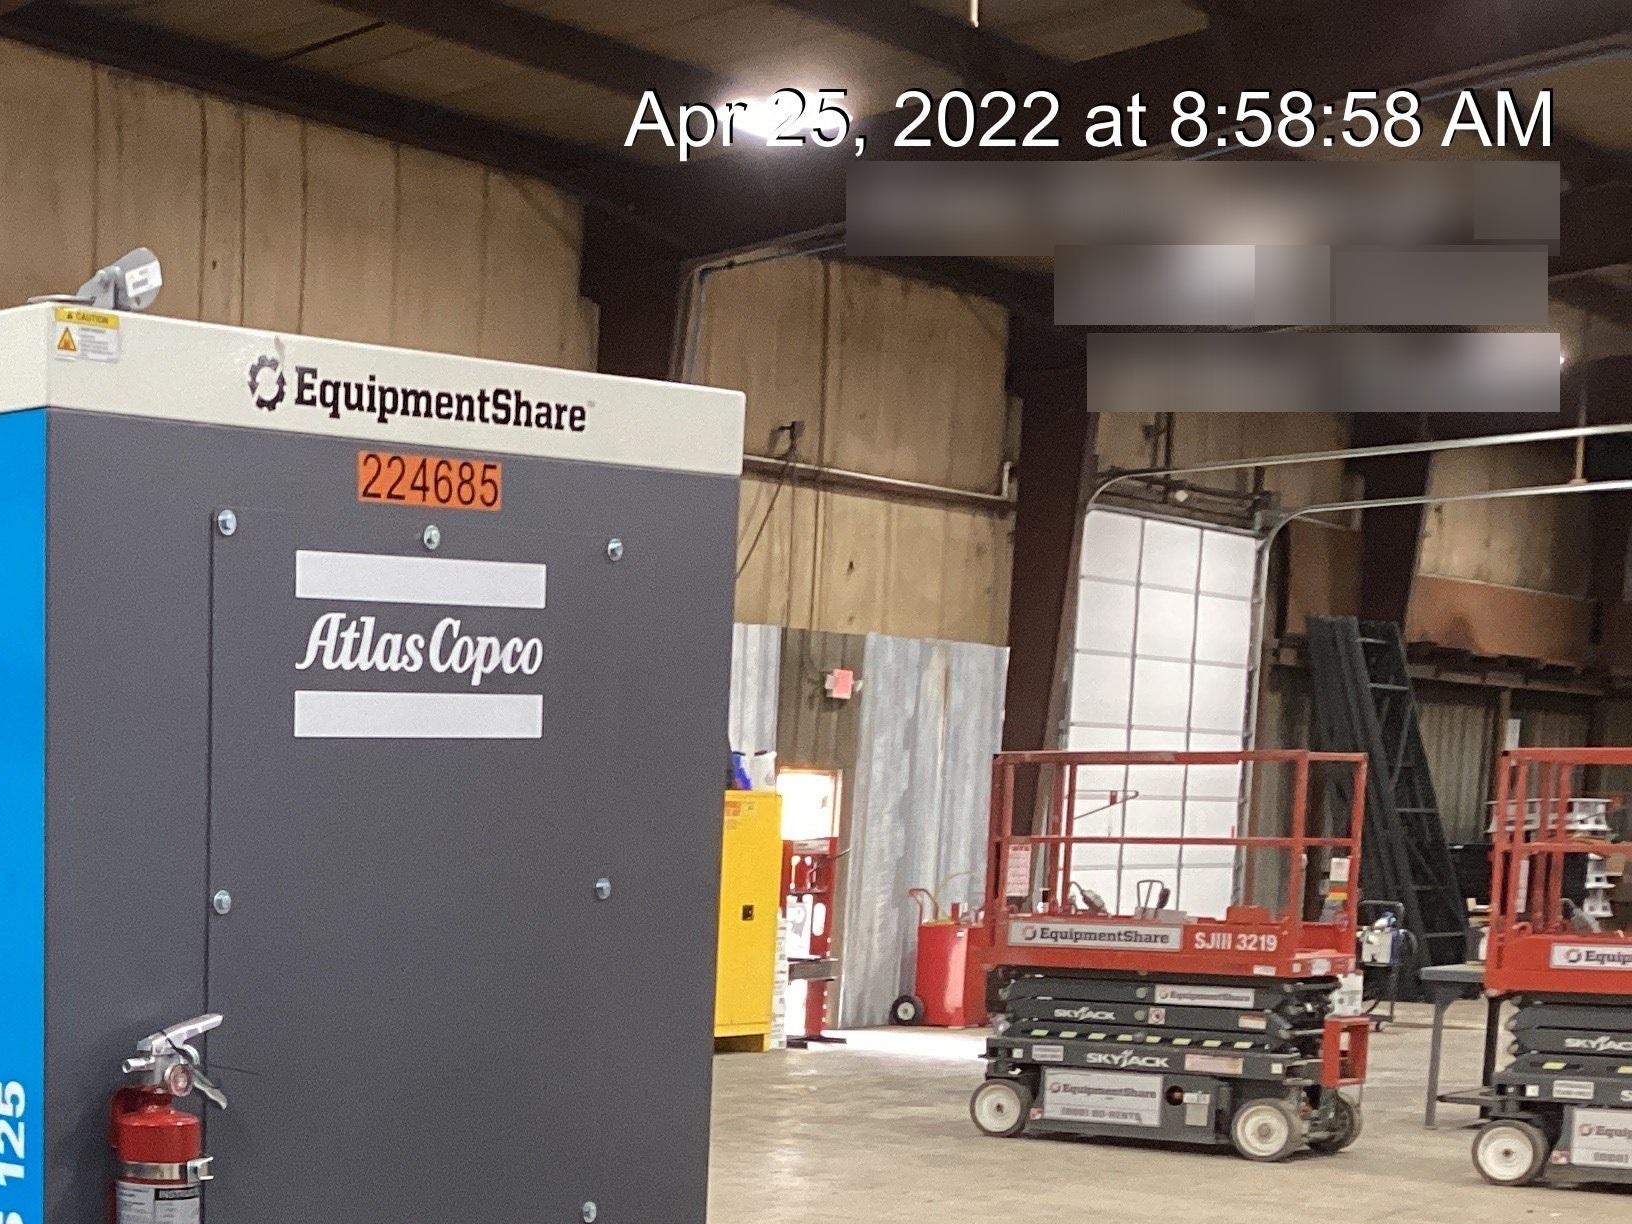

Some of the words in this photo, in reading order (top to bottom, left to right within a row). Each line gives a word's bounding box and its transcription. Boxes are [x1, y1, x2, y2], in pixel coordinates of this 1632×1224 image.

[295, 365, 586, 432] EquipmentShare
[361, 453, 499, 506] 224685
[295, 612, 425, 672] Atlas
[429, 617, 544, 686] Copco
[1039, 927, 1170, 945] EquipmentShare
[1236, 933, 1278, 952] 3219
[1086, 1049, 1169, 1068] SKYJACK
